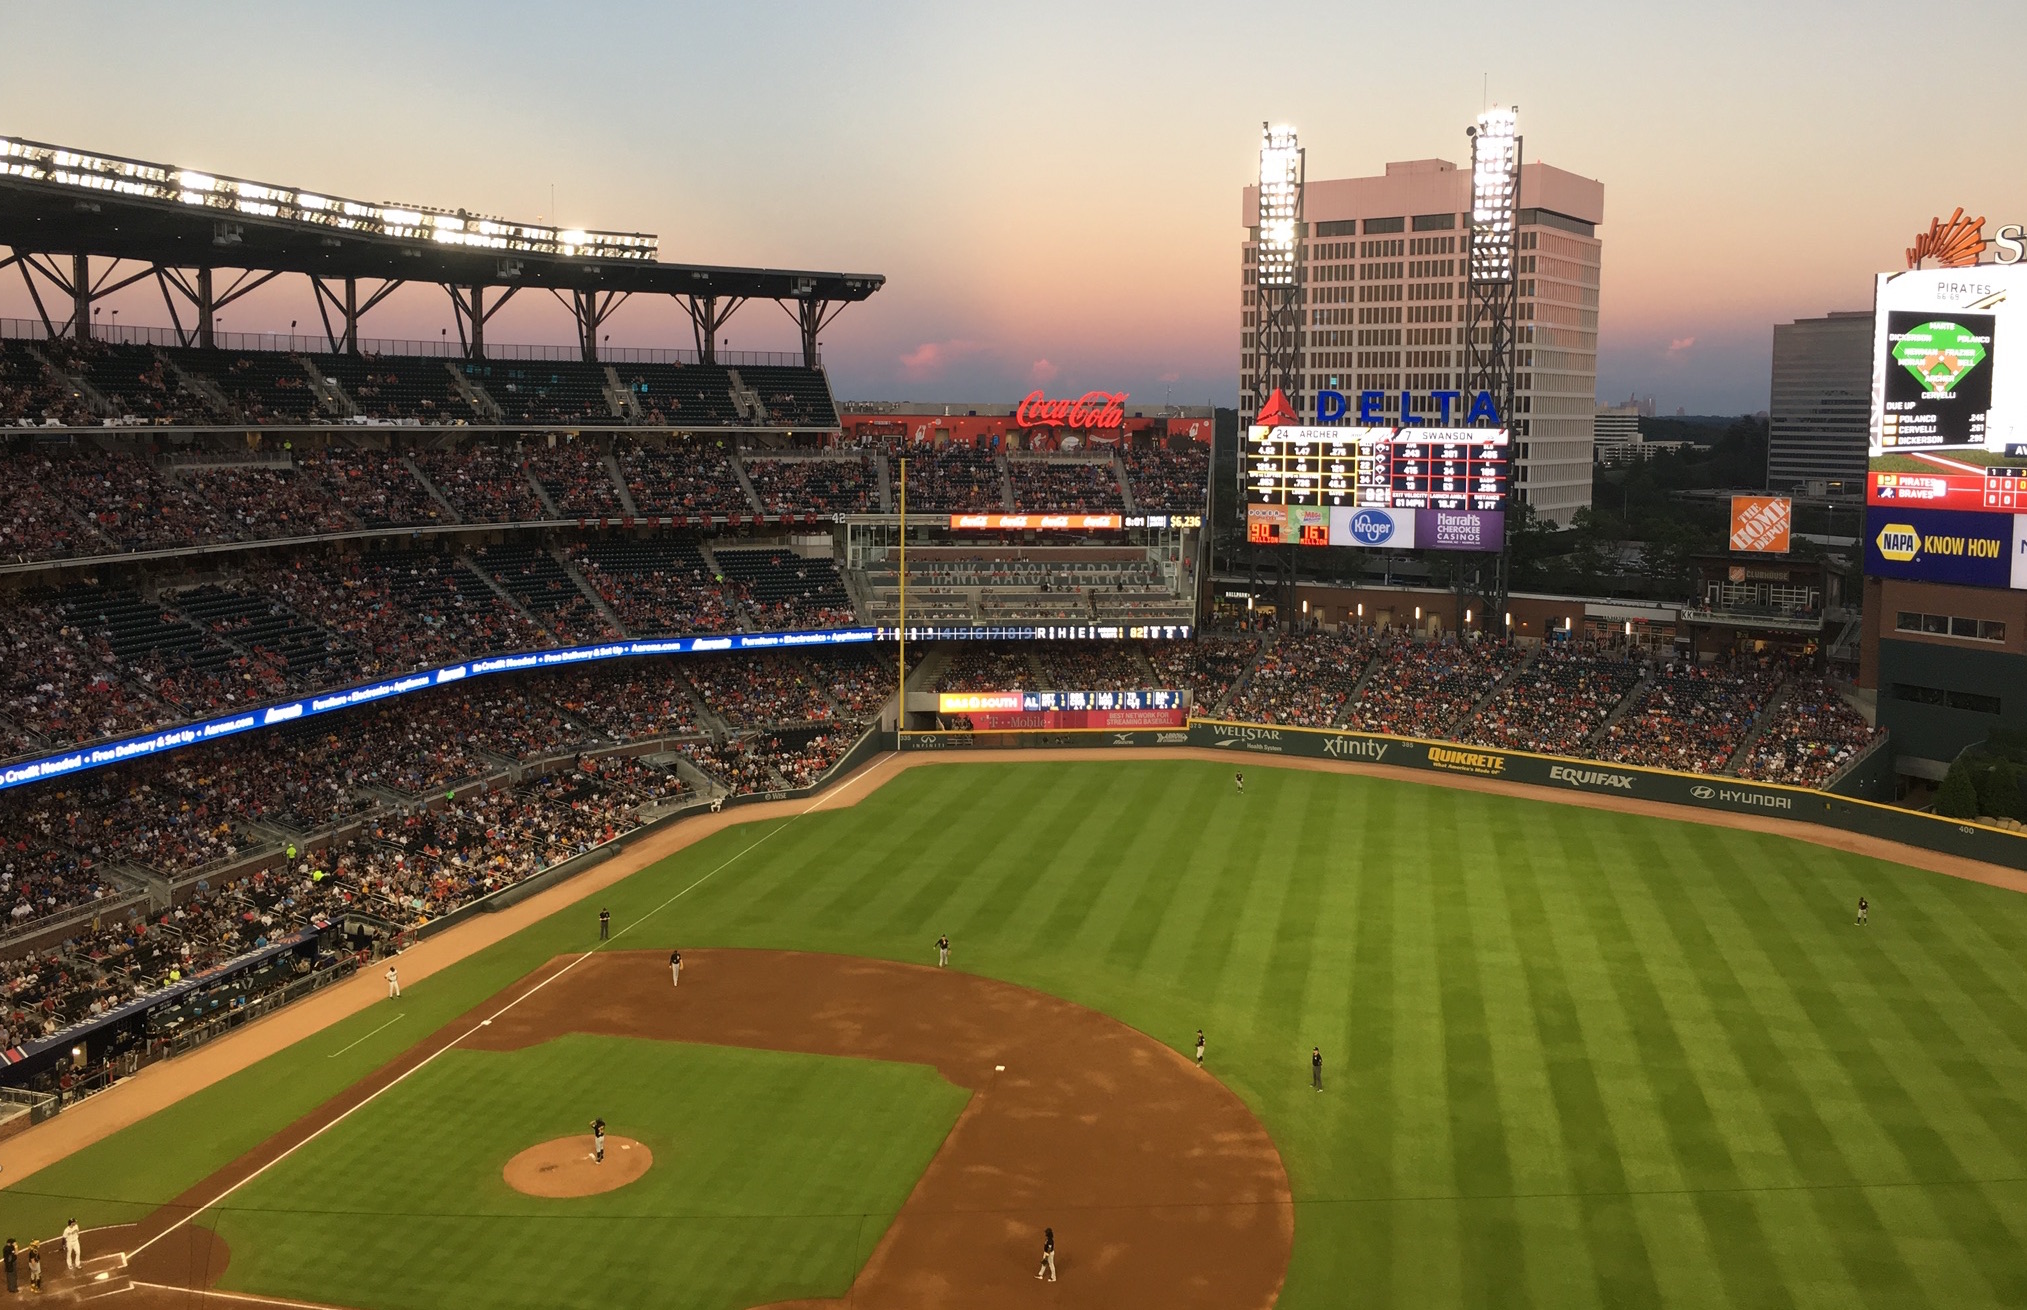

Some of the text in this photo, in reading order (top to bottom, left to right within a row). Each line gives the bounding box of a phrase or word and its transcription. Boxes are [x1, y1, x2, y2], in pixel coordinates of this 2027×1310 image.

[1937, 282, 1991, 295] PIRATES
[1957, 335, 1990, 343] POLANCO
[1921, 391, 1956, 400] CERVELLI
[1016, 390, 1130, 428] Coca-Cola
[1317, 391, 1500, 424] DELTA
[1886, 401, 1916, 410] DUE UP
[1898, 415, 1936, 423] POLANCO
[1276, 429, 1338, 439] 24 ARCHER
[1405, 431, 1473, 440] 7 SWANSON
[1898, 425, 1937, 434] CERVELLI
[1897, 436, 1944, 445] DICKERSON
[2006, 468, 2011, 476] 2
[1899, 477, 2026, 489] PIRATES 0 0 0
[1298, 496, 1304, 504] 7
[1898, 489, 2010, 504] BRAVES 0 0
[1406, 499, 1496, 509] MPH 3 FT
[832, 513, 846, 524] 42
[1437, 513, 1480, 526] Harrah's
[1737, 502, 1762, 524] THE
[1125, 517, 1145, 527] 8:01
[1170, 515, 1201, 528] $6,236
[1355, 515, 1391, 541] Kroger
[1731, 498, 1790, 550] HOME
[1251, 524, 1328, 539] 90 167
[1437, 525, 1480, 534] CHEROKEE
[1753, 518, 1789, 551] DEPOT
[1251, 536, 1279, 544] MILLION
[1437, 533, 1480, 541] CASINOS
[1883, 533, 1914, 551] NAPA
[1924, 535, 1965, 556] KNOW
[1967, 538, 2000, 558] HOW
[929, 562, 1154, 585] HANK AARON TERRACE
[1746, 570, 1788, 580] CLUBHOUSE
[741, 637, 778, 646] Furniture
[783, 634, 826, 644] Electronics
[832, 632, 872, 643] Appliances
[1037, 627, 1046, 638] R
[1058, 627, 1066, 638] H
[1078, 627, 1085, 638] E
[482, 659, 505, 671] Credit
[506, 655, 536, 667] Needed
[544, 653, 561, 663] Free
[562, 650, 593, 661] Delivery
[600, 647, 612, 656] Set
[613, 646, 623, 655] Up
[352, 684, 390, 702] Electronics
[394, 676, 429, 692] Appliances
[981, 697, 1018, 708] SOUTH
[1024, 696, 1039, 707] AL
[1214, 725, 1280, 740] WELLSTAR
[5, 765, 40, 783] Credit
[41, 755, 81, 774] Needed
[92, 747, 115, 762] Free
[115, 737, 156, 757] Delivery
[157, 736, 165, 748] &
[165, 732, 182, 746] Set
[182, 730, 195, 743] Up
[204, 717, 254, 736] Aarons.com
[1264, 744, 1282, 752] System
[1323, 735, 1388, 761] xfinity
[1428, 747, 1505, 770] QUIKRETE
[1550, 765, 1634, 789] EQUIFAX
[1720, 789, 1791, 809] HYUNDAI
[1959, 826, 1975, 835] 400
